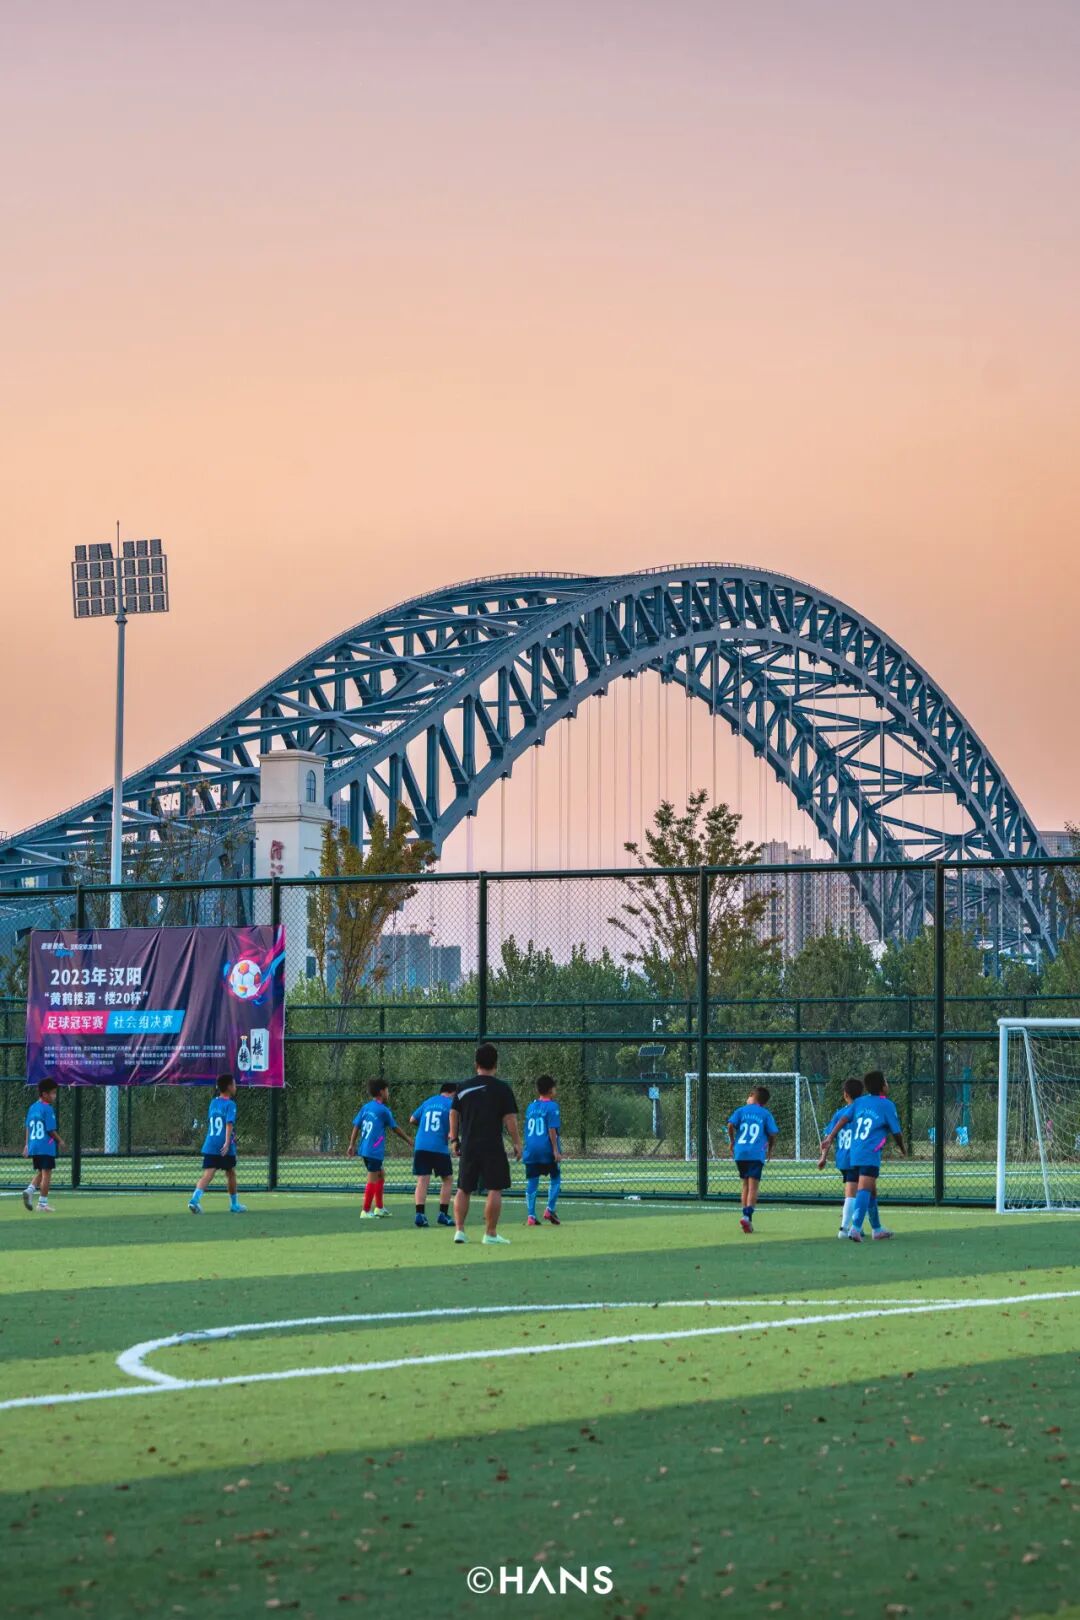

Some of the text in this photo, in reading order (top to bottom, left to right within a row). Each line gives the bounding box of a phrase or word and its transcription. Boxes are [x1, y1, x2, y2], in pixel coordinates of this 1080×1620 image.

[50, 967, 142, 987] 2023年汉阳
[47, 1015, 173, 1030] 足球冠军赛 社会组决赛
[29, 1120, 45, 1140] 28
[209, 1116, 224, 1137] 19
[424, 1111, 442, 1132] 15
[527, 1117, 545, 1137] 90
[854, 1117, 873, 1140] 13
[737, 1122, 760, 1144] 29
